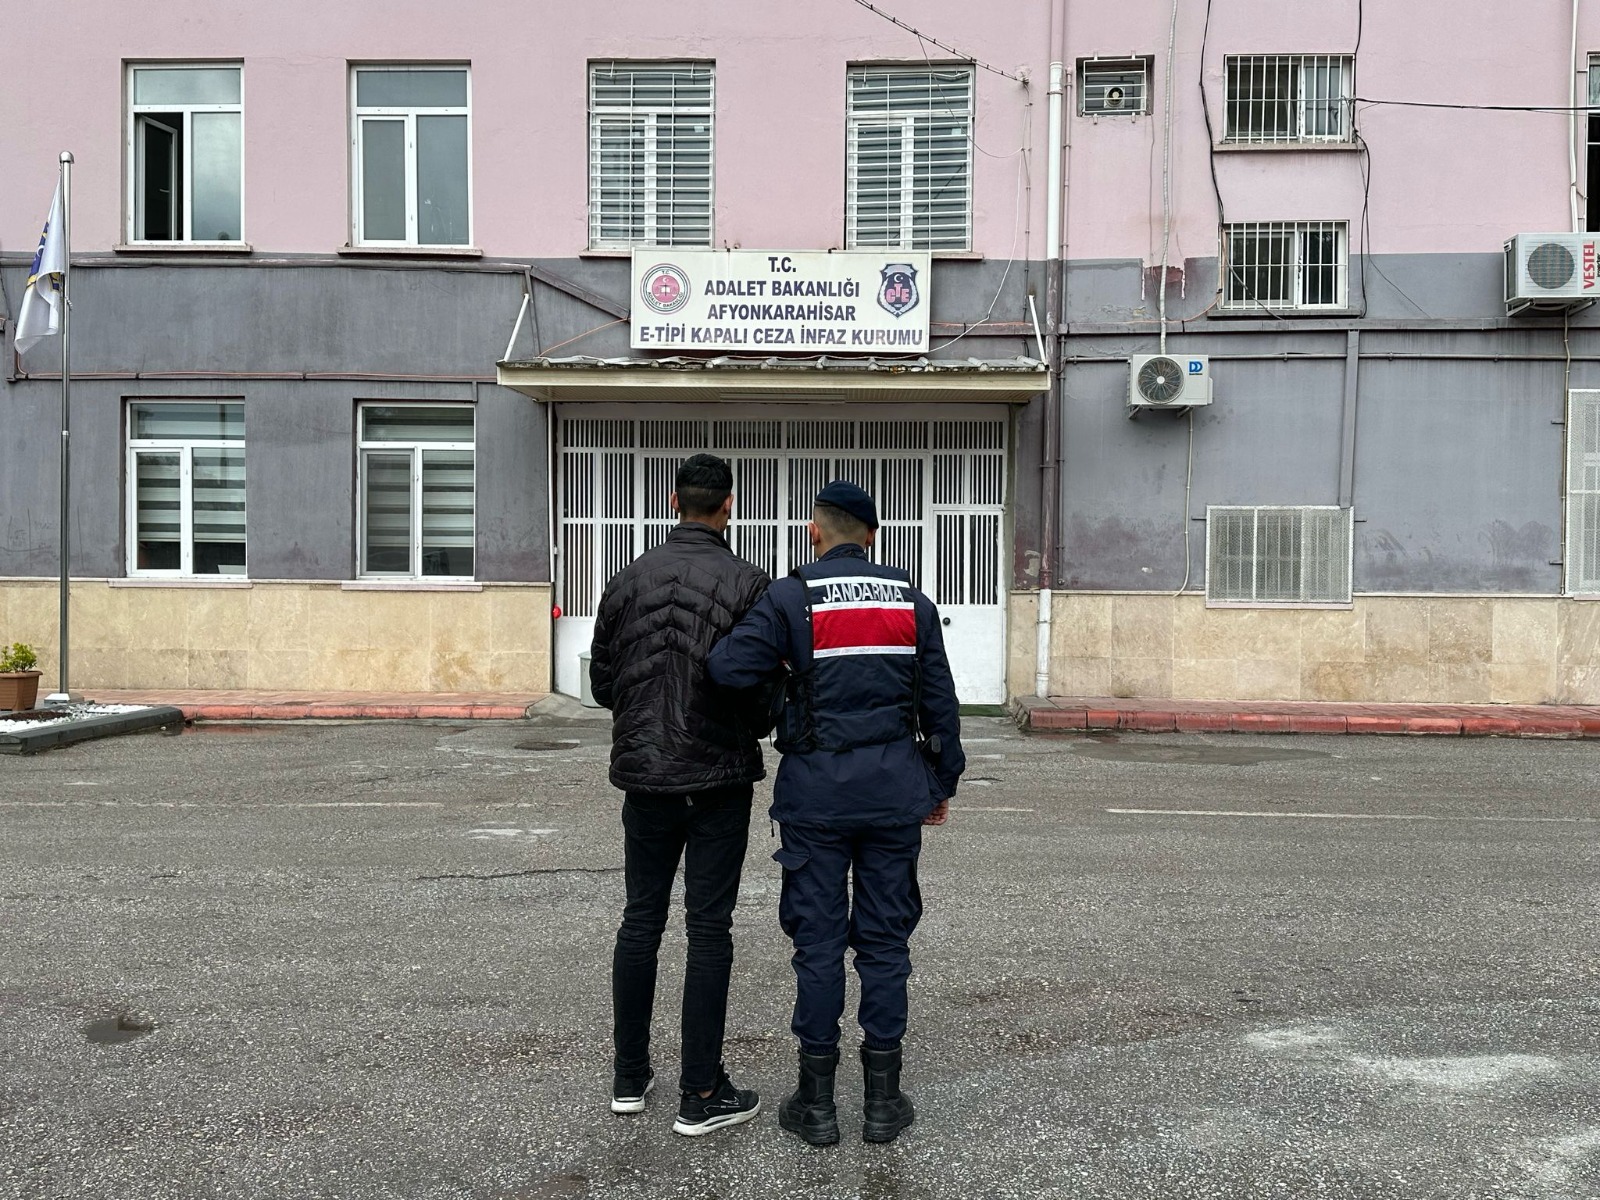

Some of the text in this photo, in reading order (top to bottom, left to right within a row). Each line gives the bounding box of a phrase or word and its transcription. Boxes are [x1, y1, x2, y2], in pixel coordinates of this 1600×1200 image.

[768, 256, 797, 273] T.C.
[1583, 241, 1595, 289] VESTEL
[704, 278, 860, 298] ADALET BAKANLIĞI
[886, 283, 910, 303] CTE
[707, 301, 856, 321] AFYONKARAHİSAR
[640, 322, 923, 346] E-TİPİ KAPALI CEZA İNFAZ KURUMU
[822, 583, 905, 603] JANDARMA
